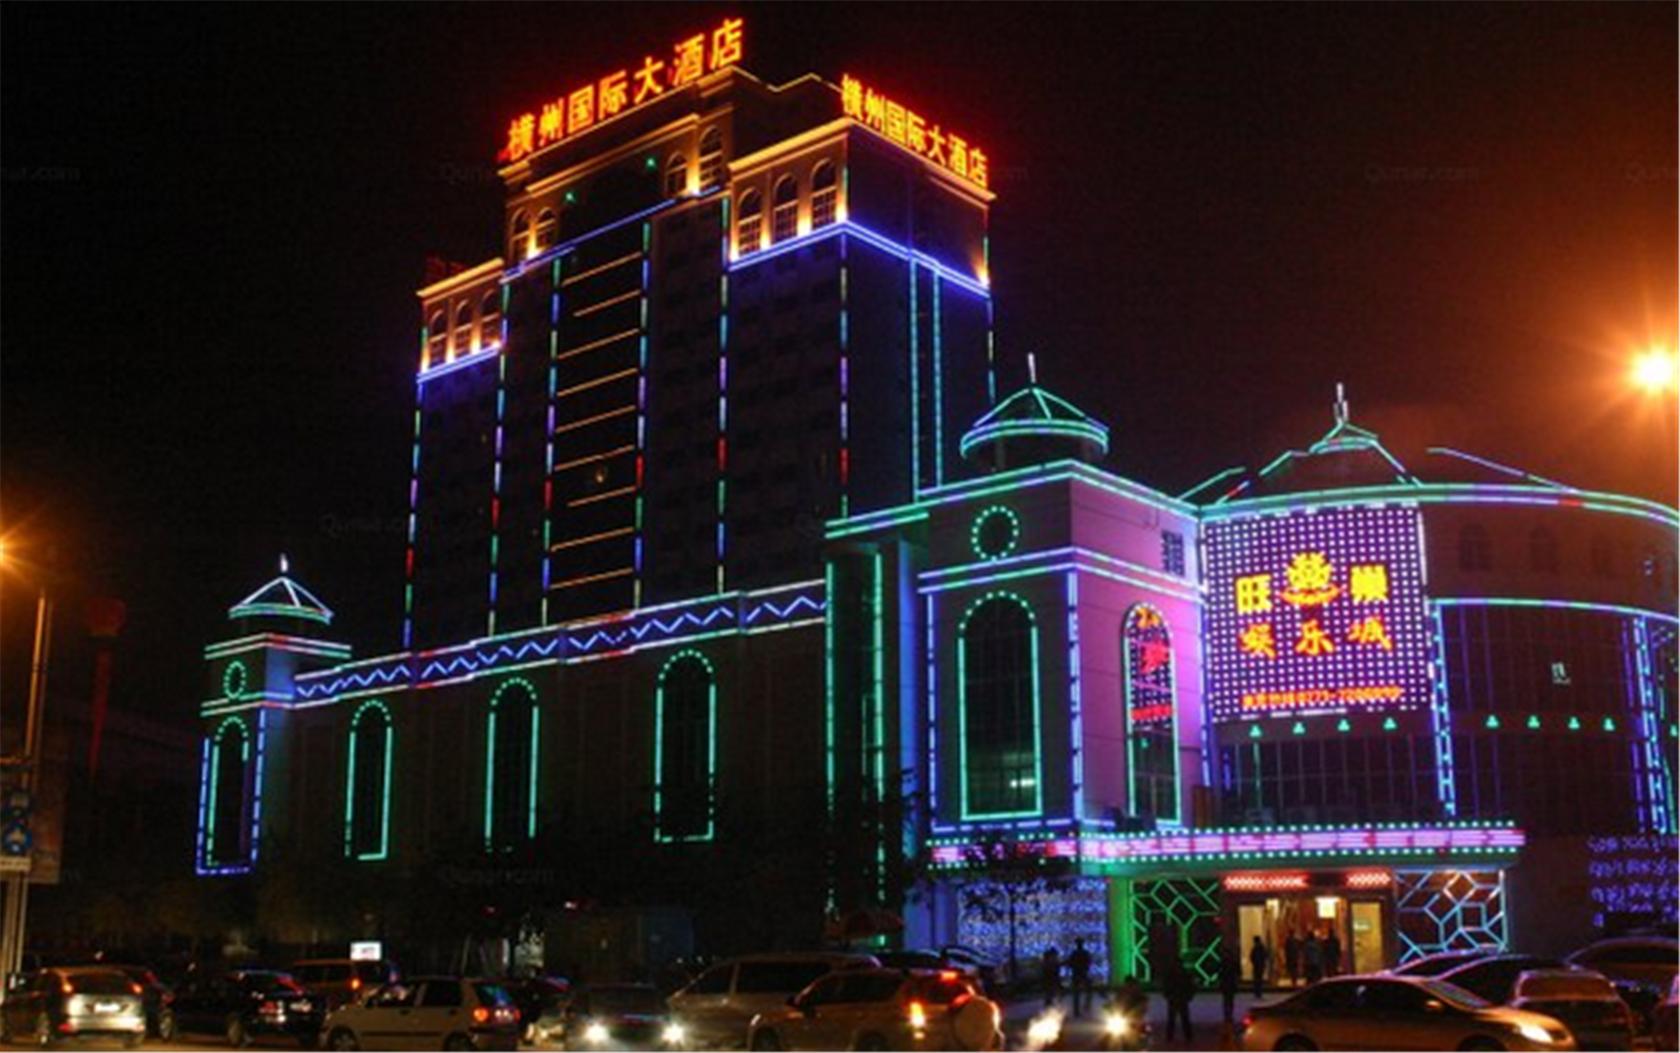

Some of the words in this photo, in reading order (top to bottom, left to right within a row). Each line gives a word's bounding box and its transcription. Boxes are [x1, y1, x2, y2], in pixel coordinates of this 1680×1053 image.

[505, 18, 743, 161] 横州国际大酒店
[841, 73, 988, 190] 横州国际大酒店
